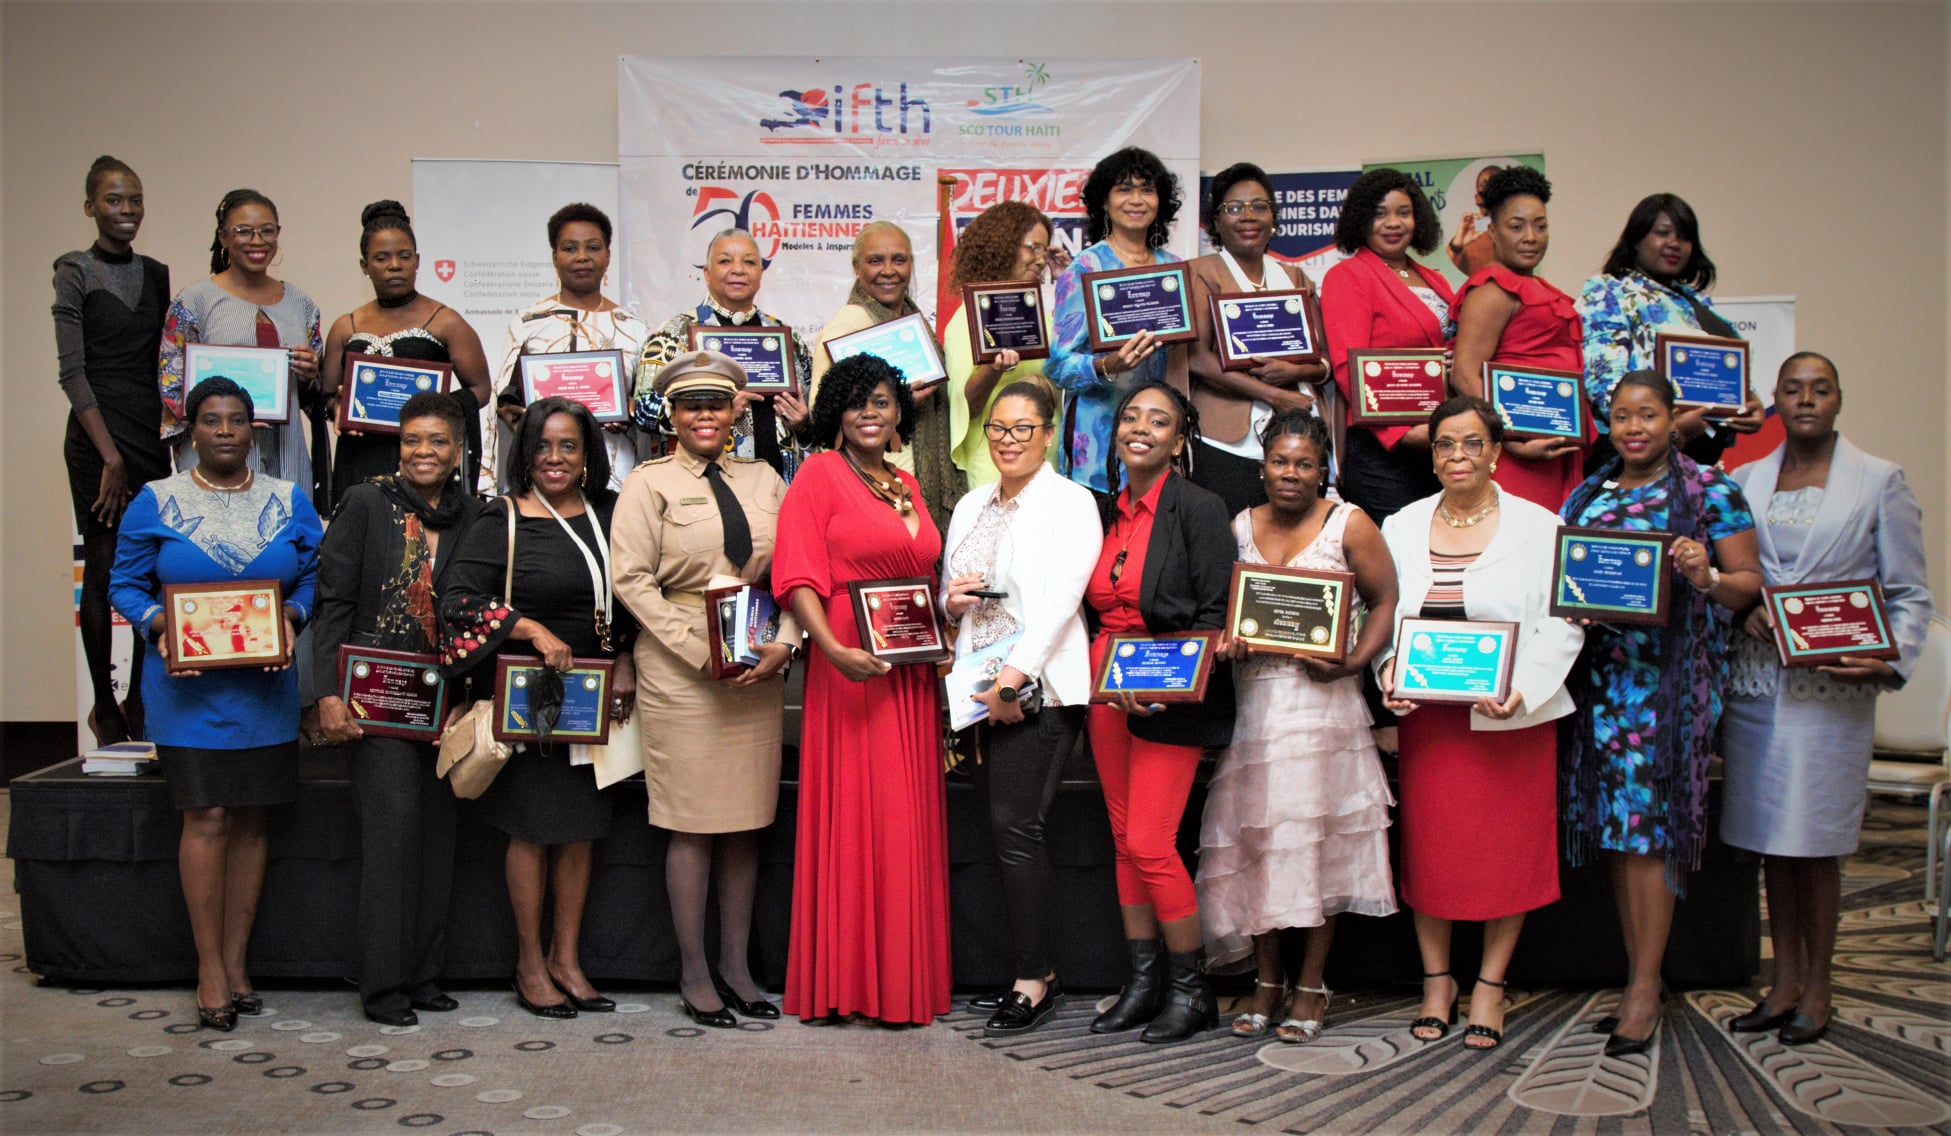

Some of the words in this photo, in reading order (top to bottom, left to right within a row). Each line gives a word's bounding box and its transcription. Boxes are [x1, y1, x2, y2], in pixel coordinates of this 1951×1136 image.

[834, 82, 931, 133] ifth
[959, 125, 984, 137] SCO
[986, 125, 1022, 137] TOUR
[682, 160, 791, 181] CÉRÉMONIE
[796, 164, 921, 181] D'HOMMAGE
[686, 187, 698, 196] de
[1286, 189, 1315, 203] DES
[793, 204, 873, 219] FEMMES
